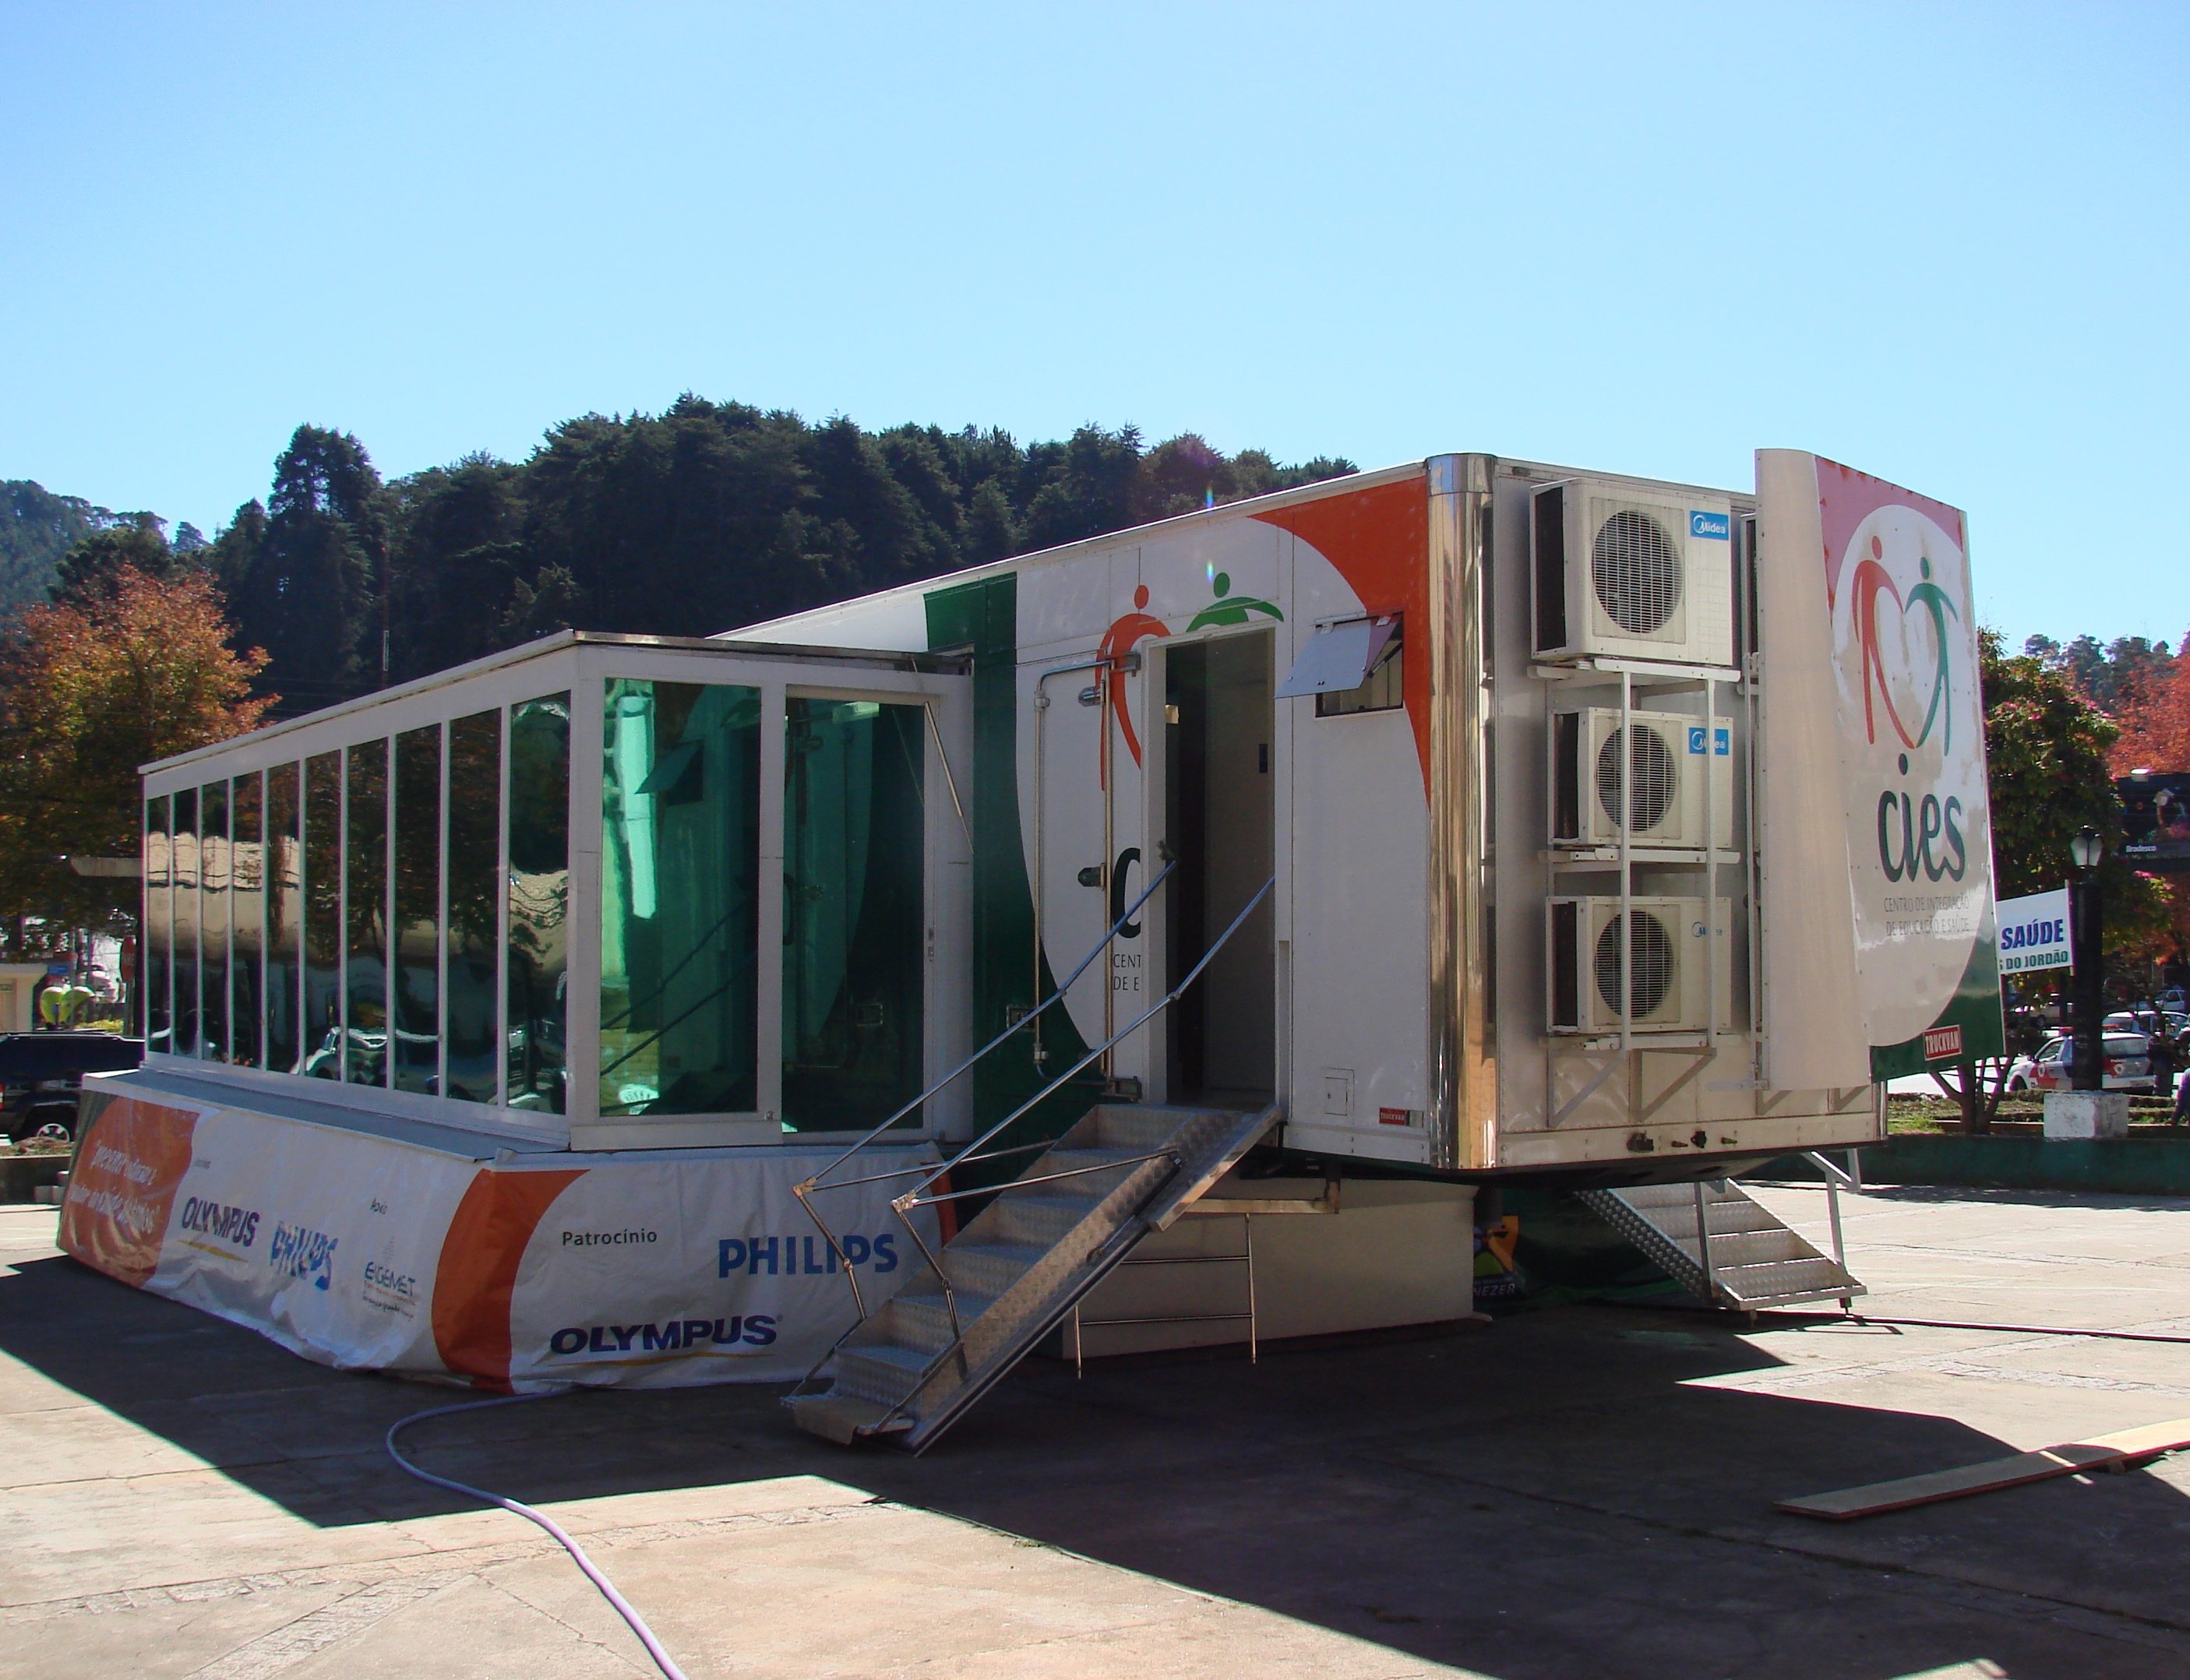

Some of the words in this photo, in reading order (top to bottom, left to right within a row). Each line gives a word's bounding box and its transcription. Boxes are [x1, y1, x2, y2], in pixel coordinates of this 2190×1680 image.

[1693, 515, 1726, 534] Midea
[1691, 731, 1725, 750] Mea
[1884, 897, 1913, 912] CENTRO
[1915, 896, 1925, 910] DE
[1886, 921, 1896, 936] DE
[2001, 918, 2064, 949] SAÚDE
[2005, 957, 2021, 970] DO
[2024, 949, 2068, 967] JORDÃO
[1113, 976, 1128, 991] DE
[1924, 1030, 1959, 1055] TRUCKVAN
[182, 1196, 260, 1247] OLYMPUS
[562, 1228, 658, 1246] Patrocínio
[719, 1234, 898, 1278] PHILIPS
[551, 1315, 777, 1354] OLYMPUS
